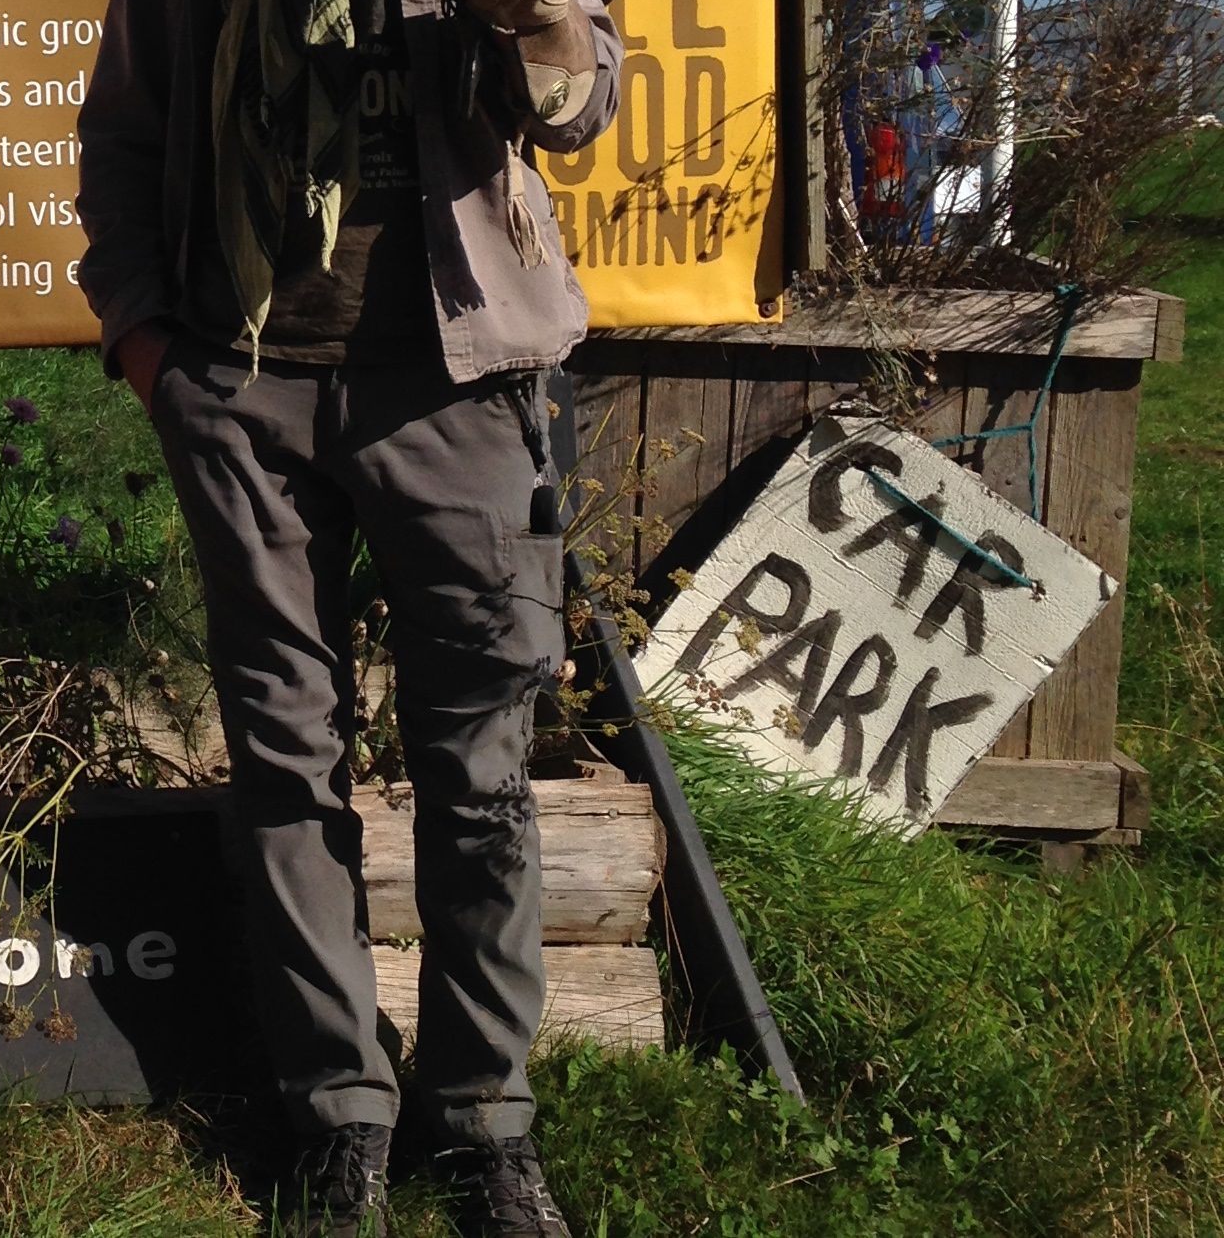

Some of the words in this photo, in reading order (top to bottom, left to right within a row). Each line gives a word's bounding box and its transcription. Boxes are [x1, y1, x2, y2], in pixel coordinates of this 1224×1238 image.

[24, 70, 86, 107] and
[807, 440, 1025, 657] CAR
[675, 551, 995, 812] PARK
